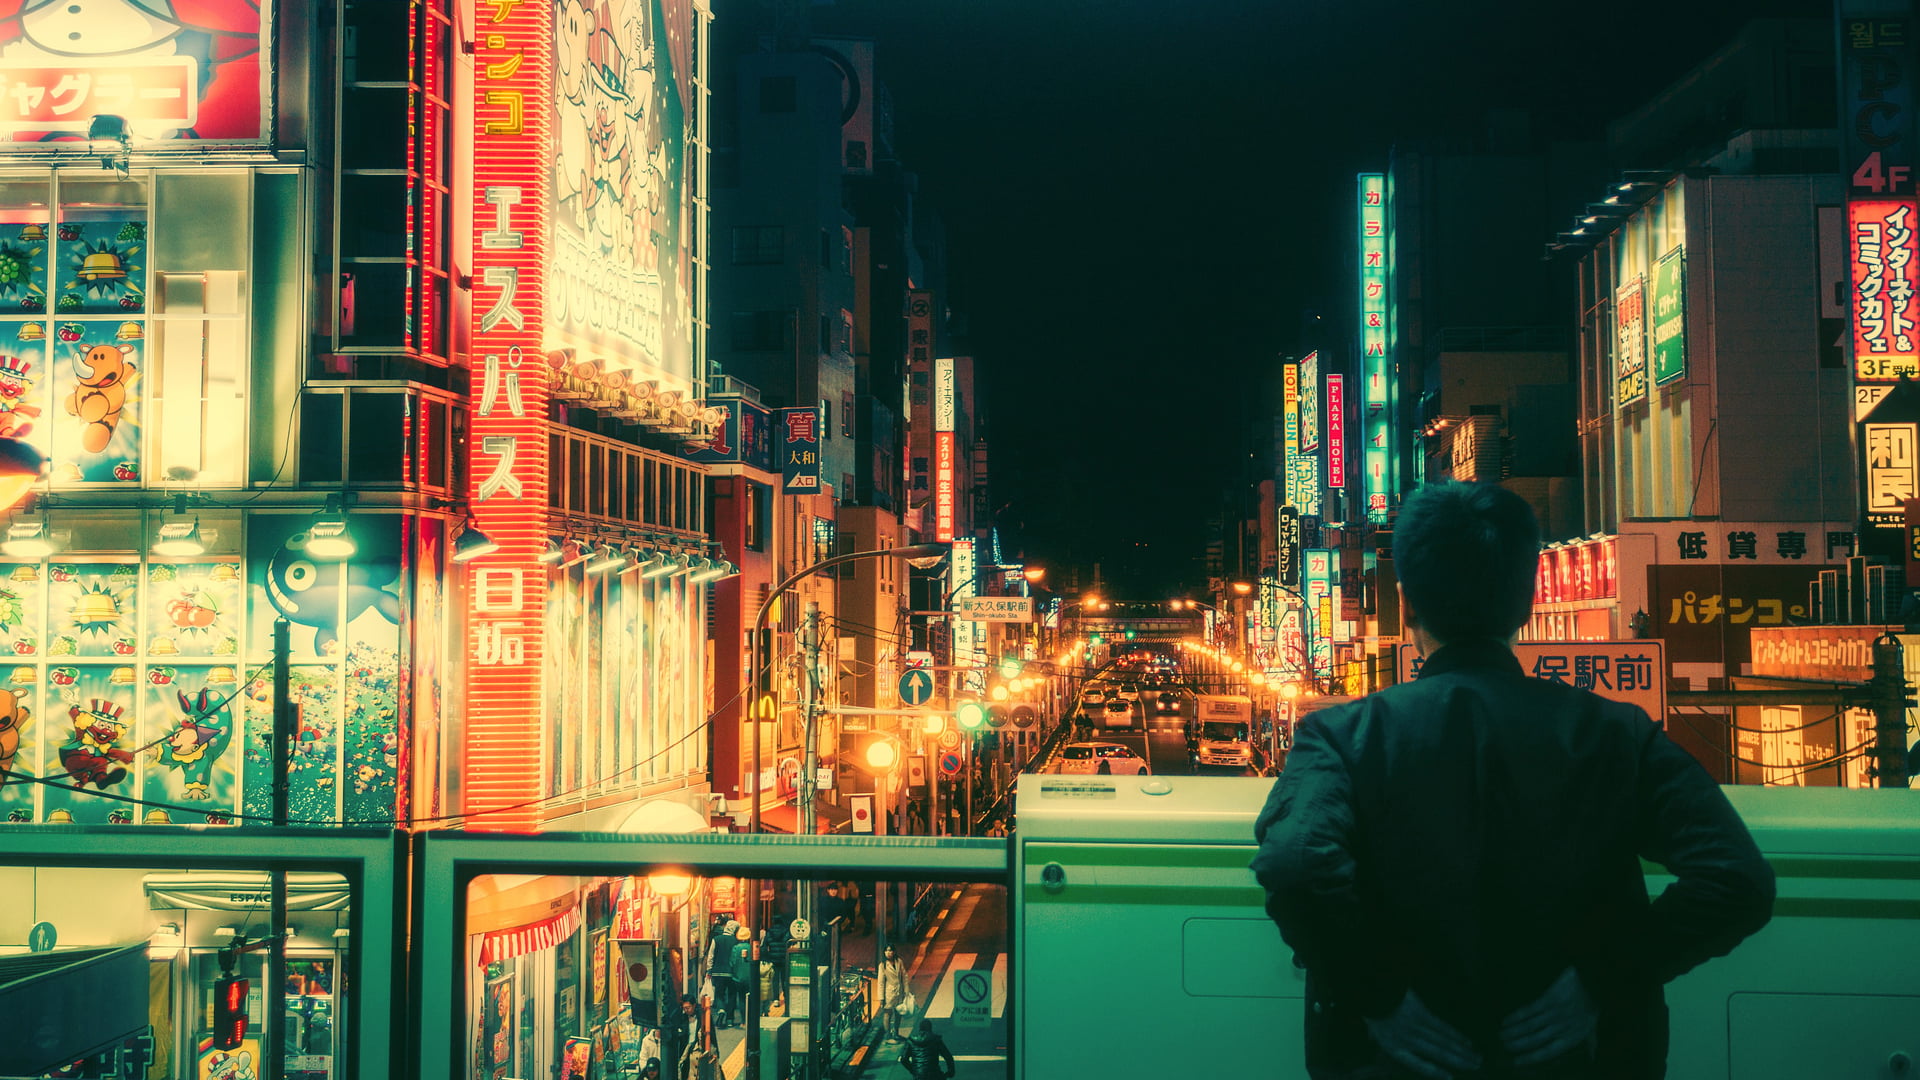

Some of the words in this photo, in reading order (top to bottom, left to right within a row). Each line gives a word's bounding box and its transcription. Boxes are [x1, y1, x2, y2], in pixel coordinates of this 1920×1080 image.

[1849, 22, 1905, 49] 월드
[0, 73, 181, 116] ャグラー
[1852, 152, 1911, 193] 4F
[1859, 223, 1888, 352] コミックカフェ
[478, 186, 525, 502] エスパス
[1862, 360, 1891, 376] 3F
[1286, 367, 1296, 405] HOTEL
[1858, 388, 1881, 403] 2F
[1331, 386, 1340, 430] PLAZA
[785, 411, 816, 443] 質
[1286, 412, 1296, 441] SUN
[789, 450, 815, 465] 大和
[1331, 439, 1341, 484] HOTEL
[1870, 429, 1912, 508] 和民
[795, 476, 814, 486] 入口
[1677, 531, 1850, 560] 低貸専門
[473, 567, 525, 665] 日拓
[964, 601, 1028, 611] 新大久保駅前
[230, 893, 271, 903] ESPAC
